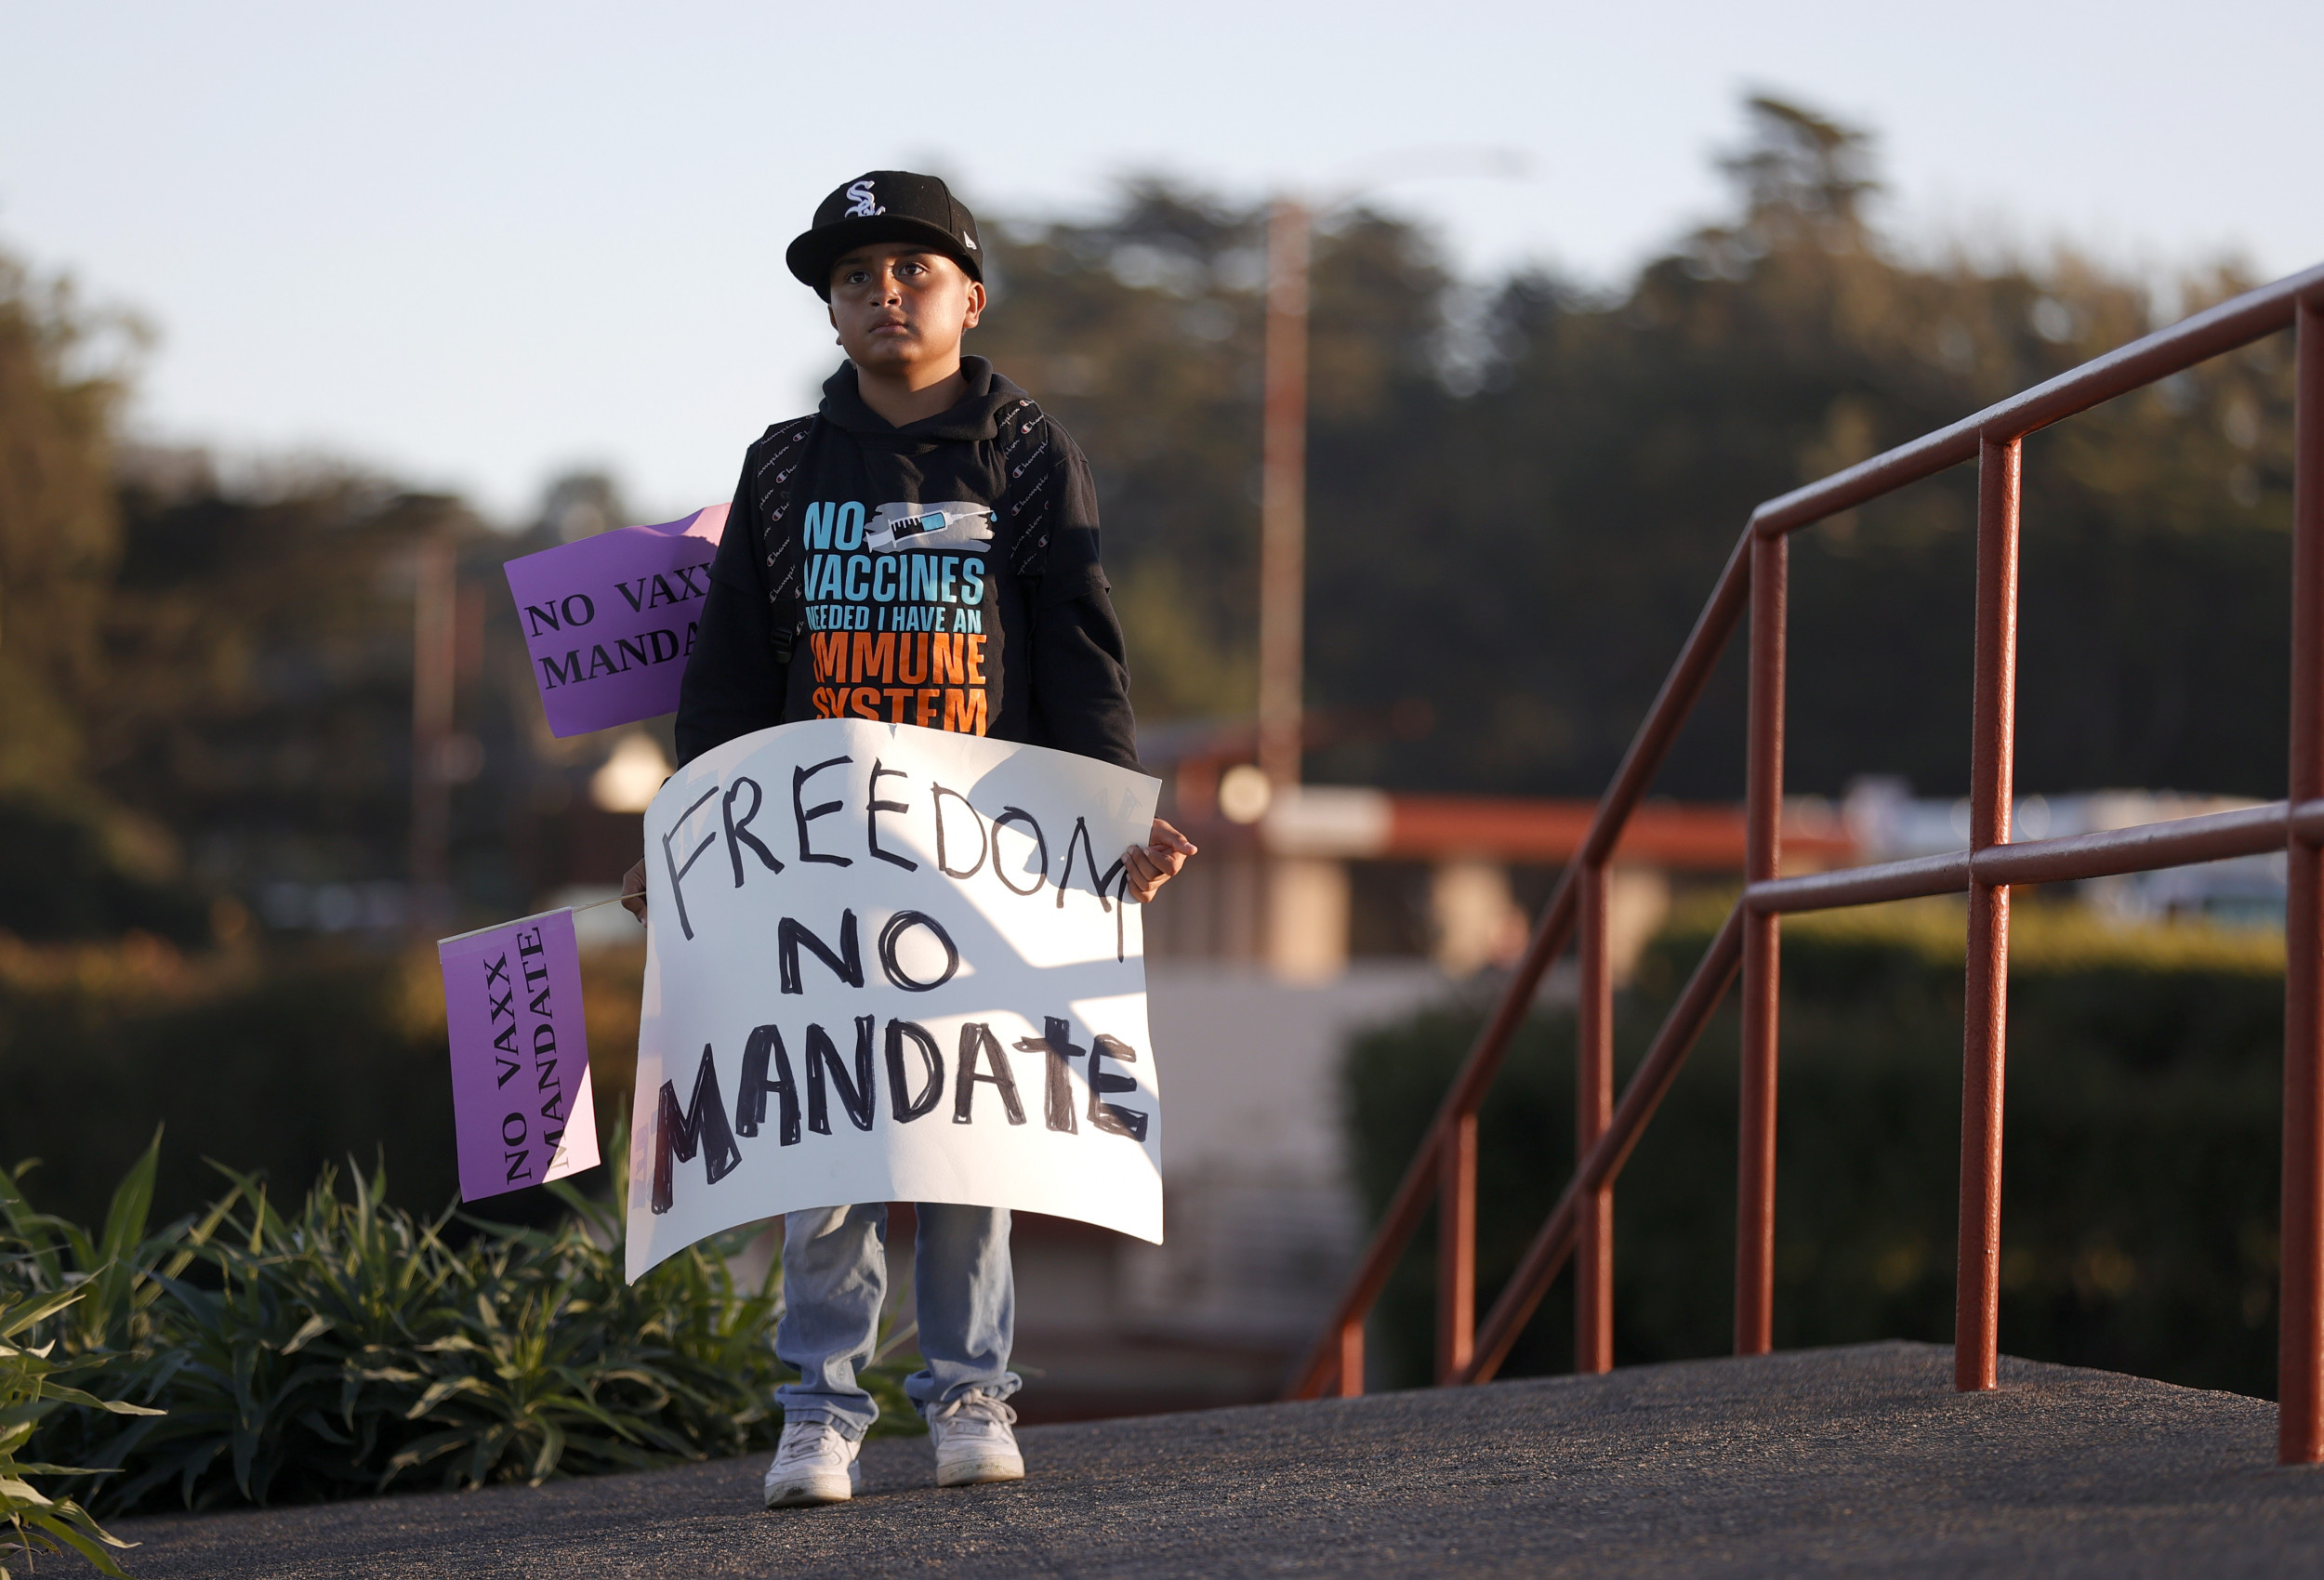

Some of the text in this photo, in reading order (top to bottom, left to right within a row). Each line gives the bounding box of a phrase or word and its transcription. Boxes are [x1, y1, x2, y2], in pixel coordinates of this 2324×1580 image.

[803, 501, 865, 551] NO
[804, 554, 985, 605] VACCINES
[523, 593, 596, 638] NO
[805, 604, 870, 632] NEEDED
[878, 606, 886, 631] I
[891, 606, 946, 632] HAVE
[953, 608, 983, 634] AN
[811, 631, 988, 685] IMMUNE
[663, 755, 1129, 964] FREEDOM
[777, 907, 961, 995] NO
[482, 952, 533, 1185] NO VAXX
[517, 927, 570, 1176] MANDATE
